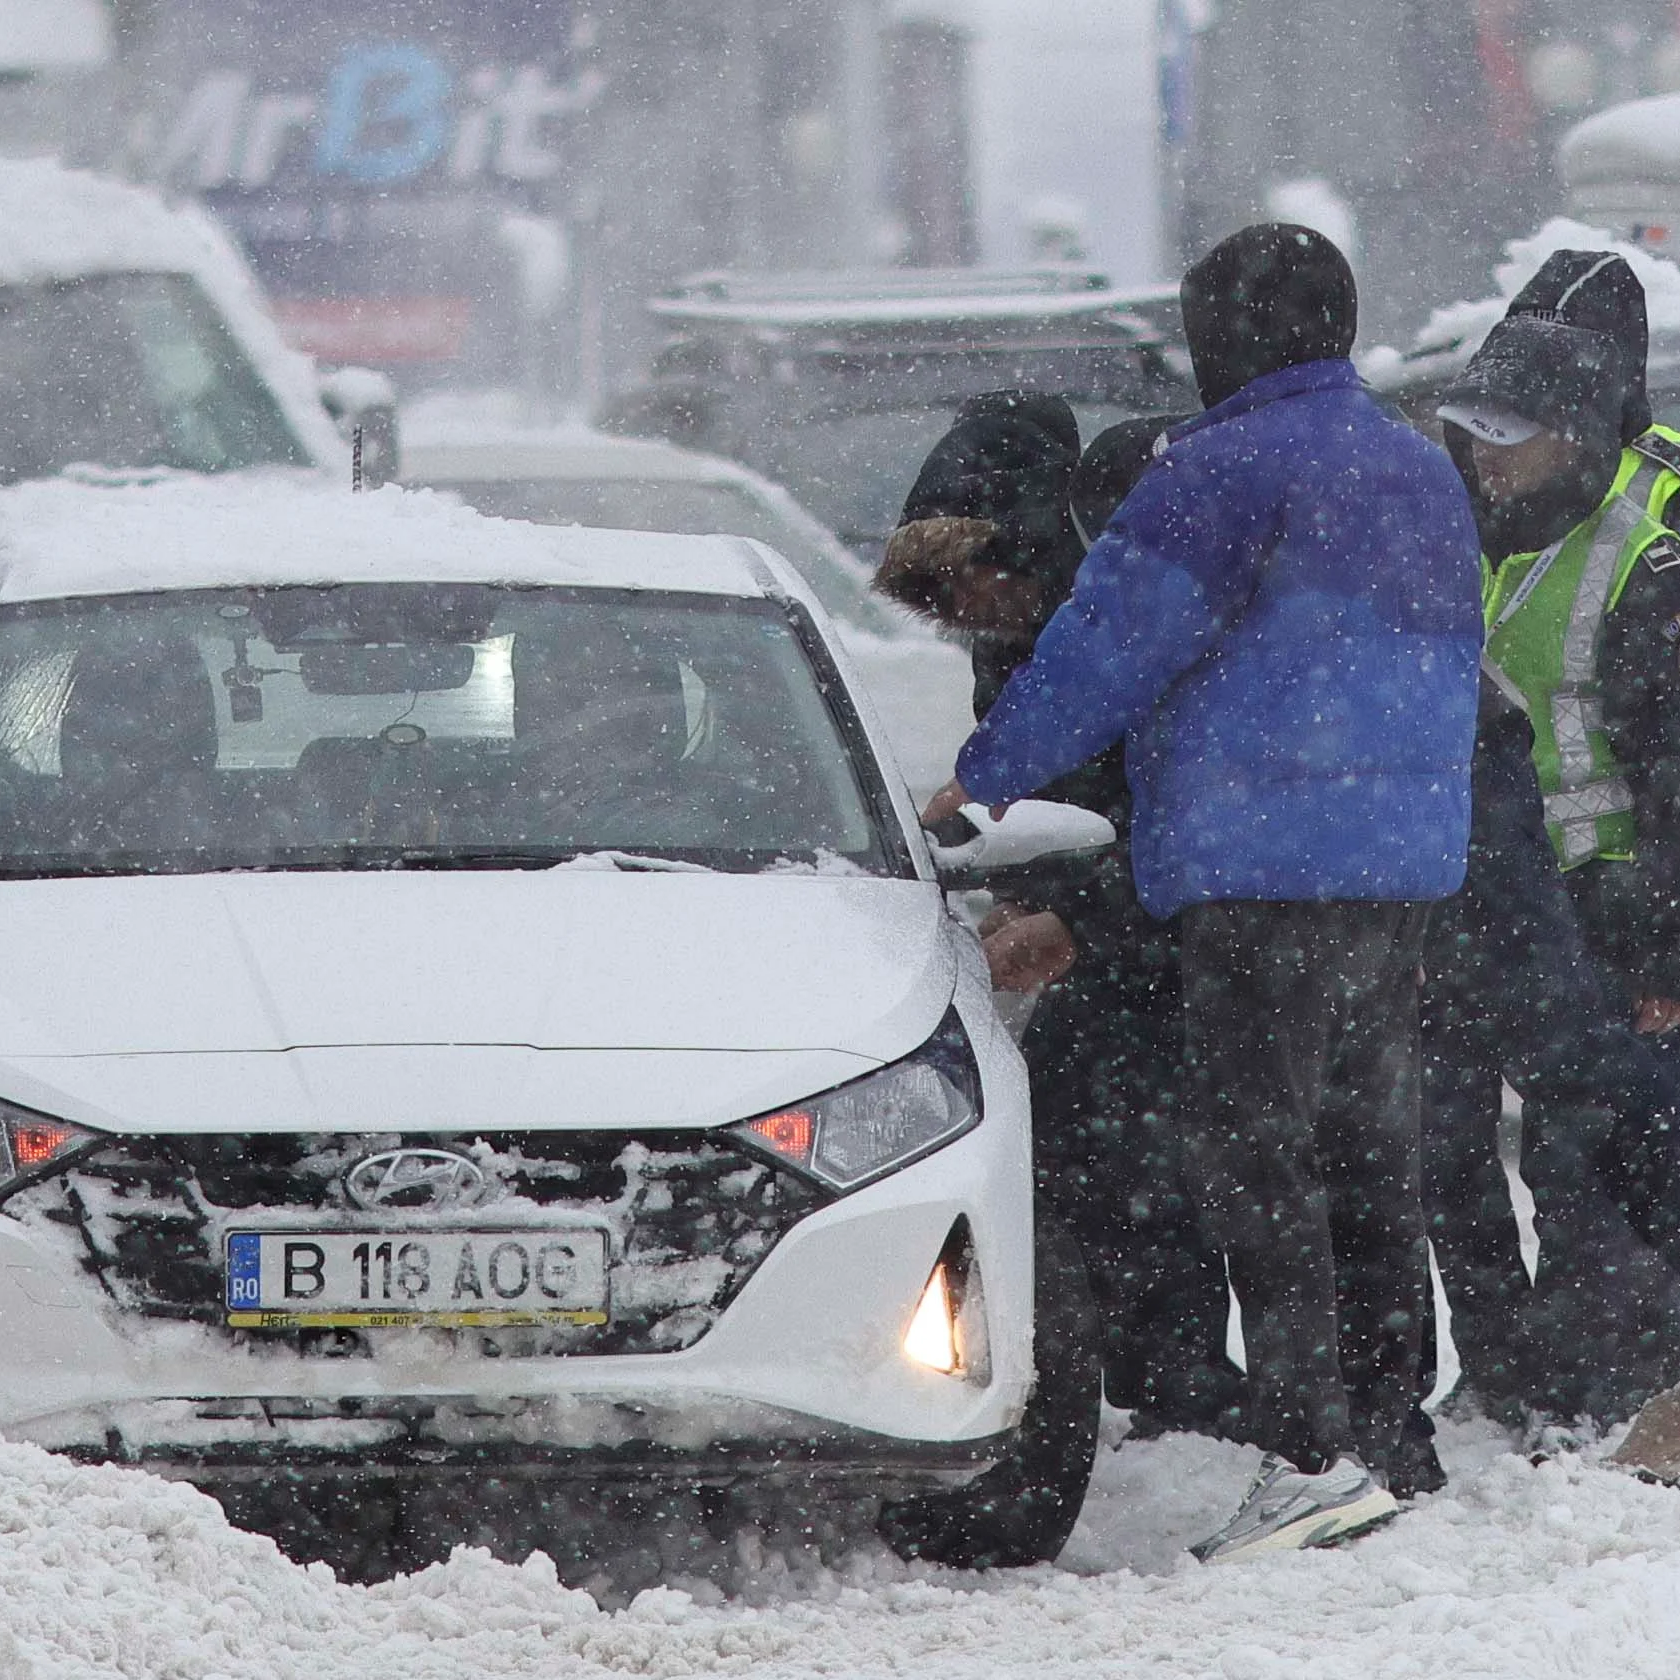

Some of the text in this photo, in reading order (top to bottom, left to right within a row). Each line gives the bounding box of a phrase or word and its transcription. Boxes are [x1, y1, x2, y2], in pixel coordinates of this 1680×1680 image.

[284, 1242, 325, 1299] B
[352, 1242, 430, 1299] 118
[232, 1278, 258, 1299] RO
[370, 1315, 389, 1326] 021
